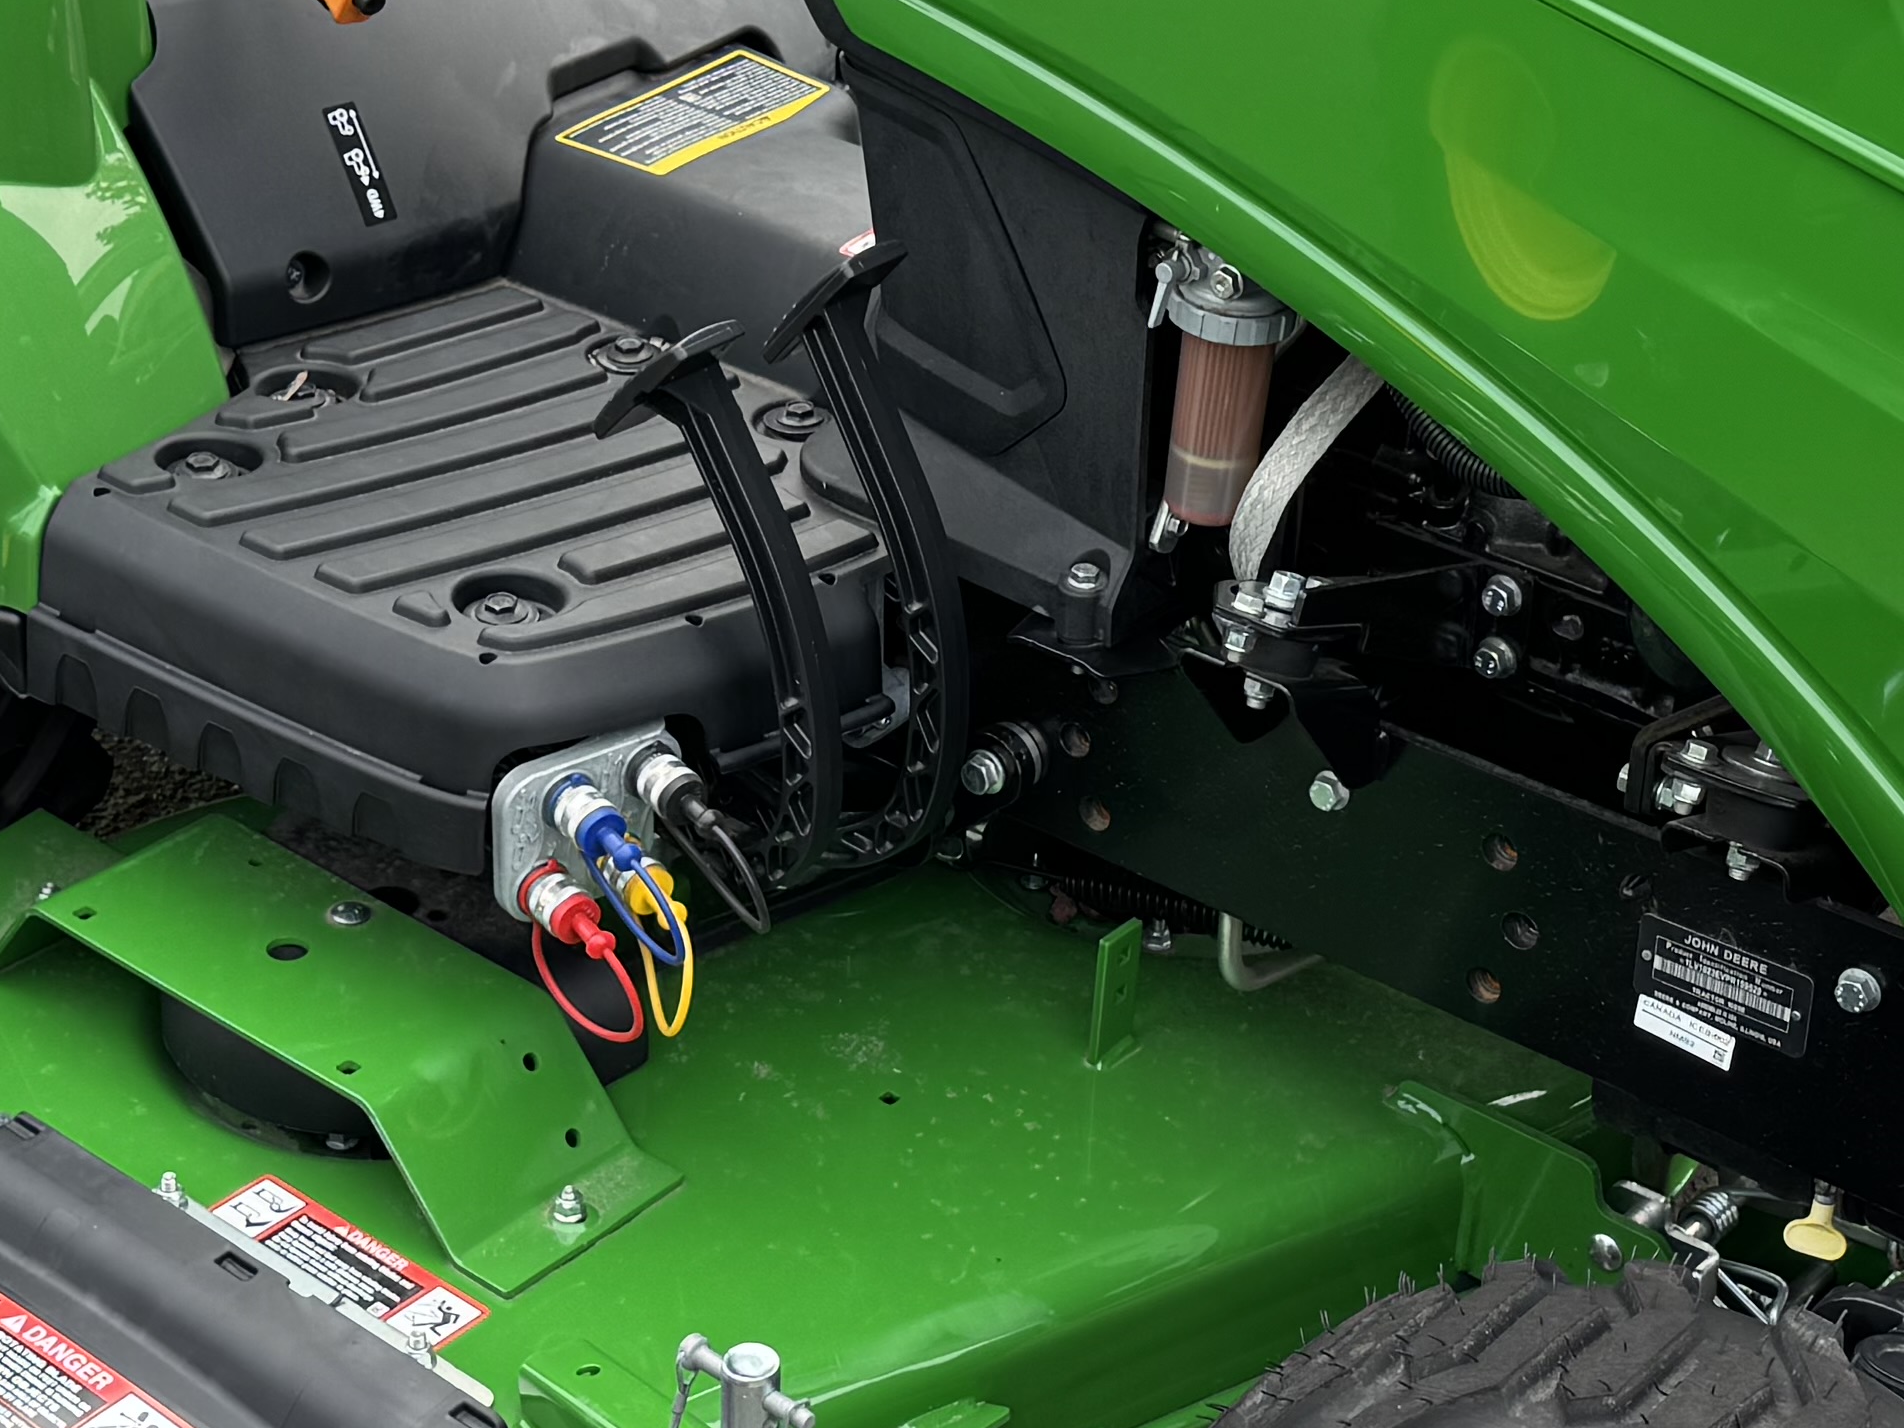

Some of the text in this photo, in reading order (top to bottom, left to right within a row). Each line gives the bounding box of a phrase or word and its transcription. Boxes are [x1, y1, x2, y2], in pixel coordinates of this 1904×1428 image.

[1666, 941, 1694, 960] Product
[1684, 934, 1768, 975] JOHN DEERE
[1643, 998, 1682, 1022] CANADA
[348, 1230, 409, 1271] DANGER
[22, 1326, 116, 1391] DANGER
